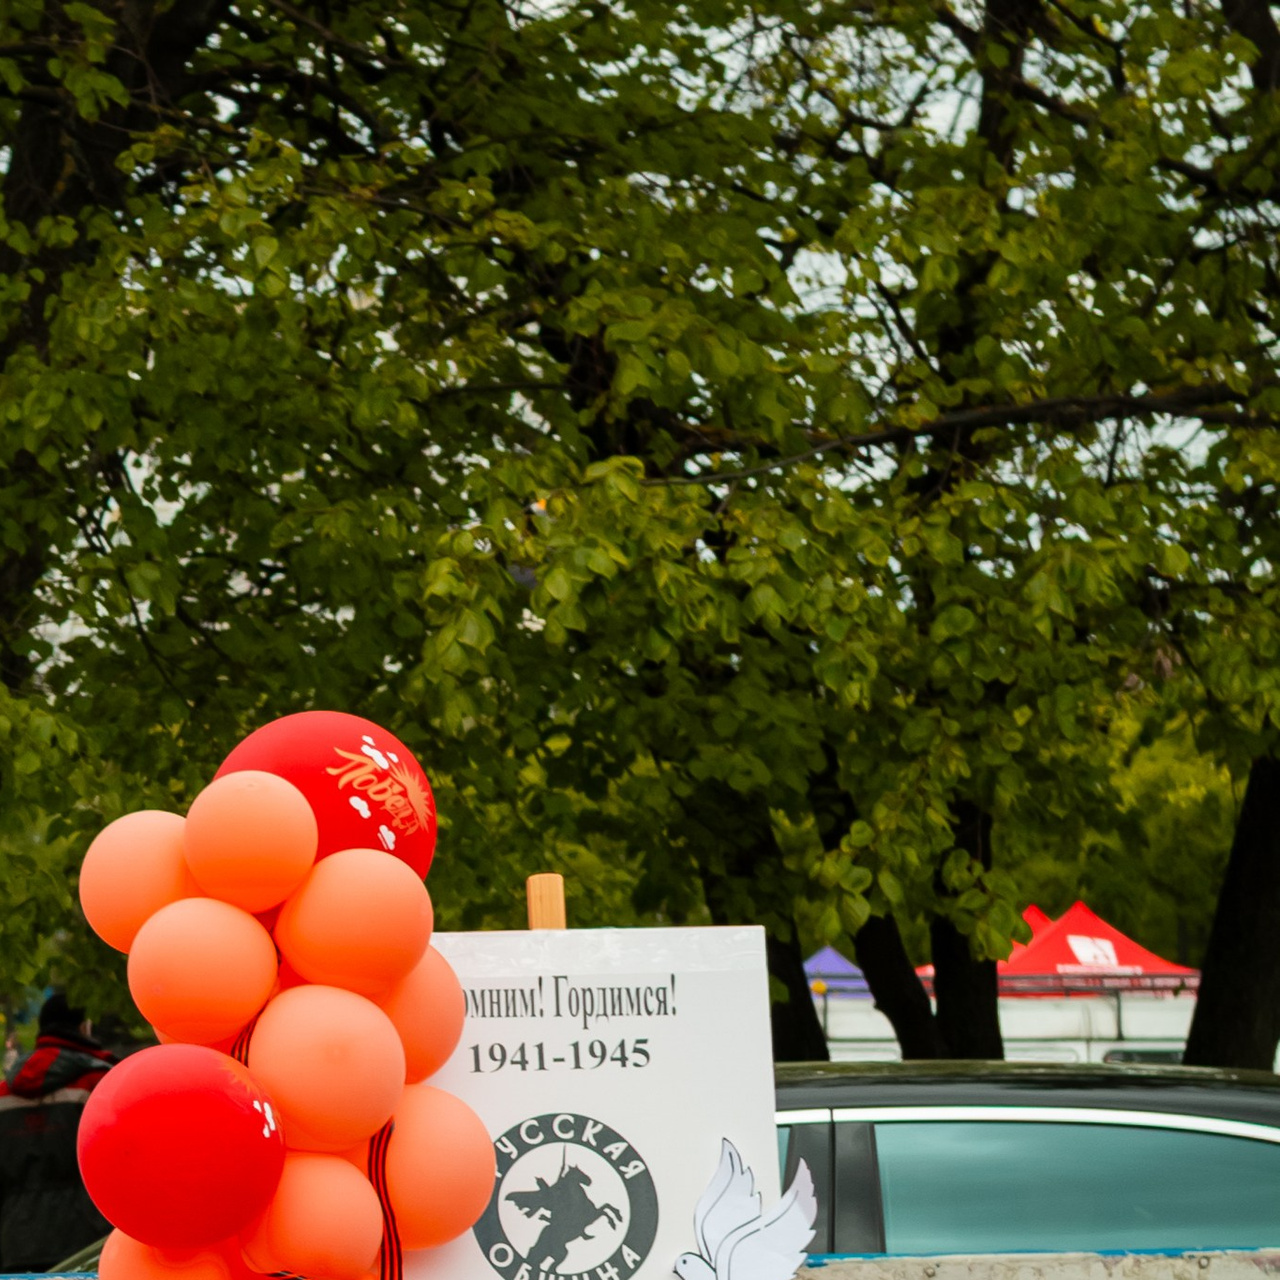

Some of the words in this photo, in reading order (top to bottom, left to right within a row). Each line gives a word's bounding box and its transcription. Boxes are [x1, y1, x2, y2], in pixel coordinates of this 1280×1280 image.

[552, 973, 677, 1029] Гордимся!
[469, 1038, 651, 1073] 1941-1945
[495, 1114, 646, 1179] УССКАЯ
